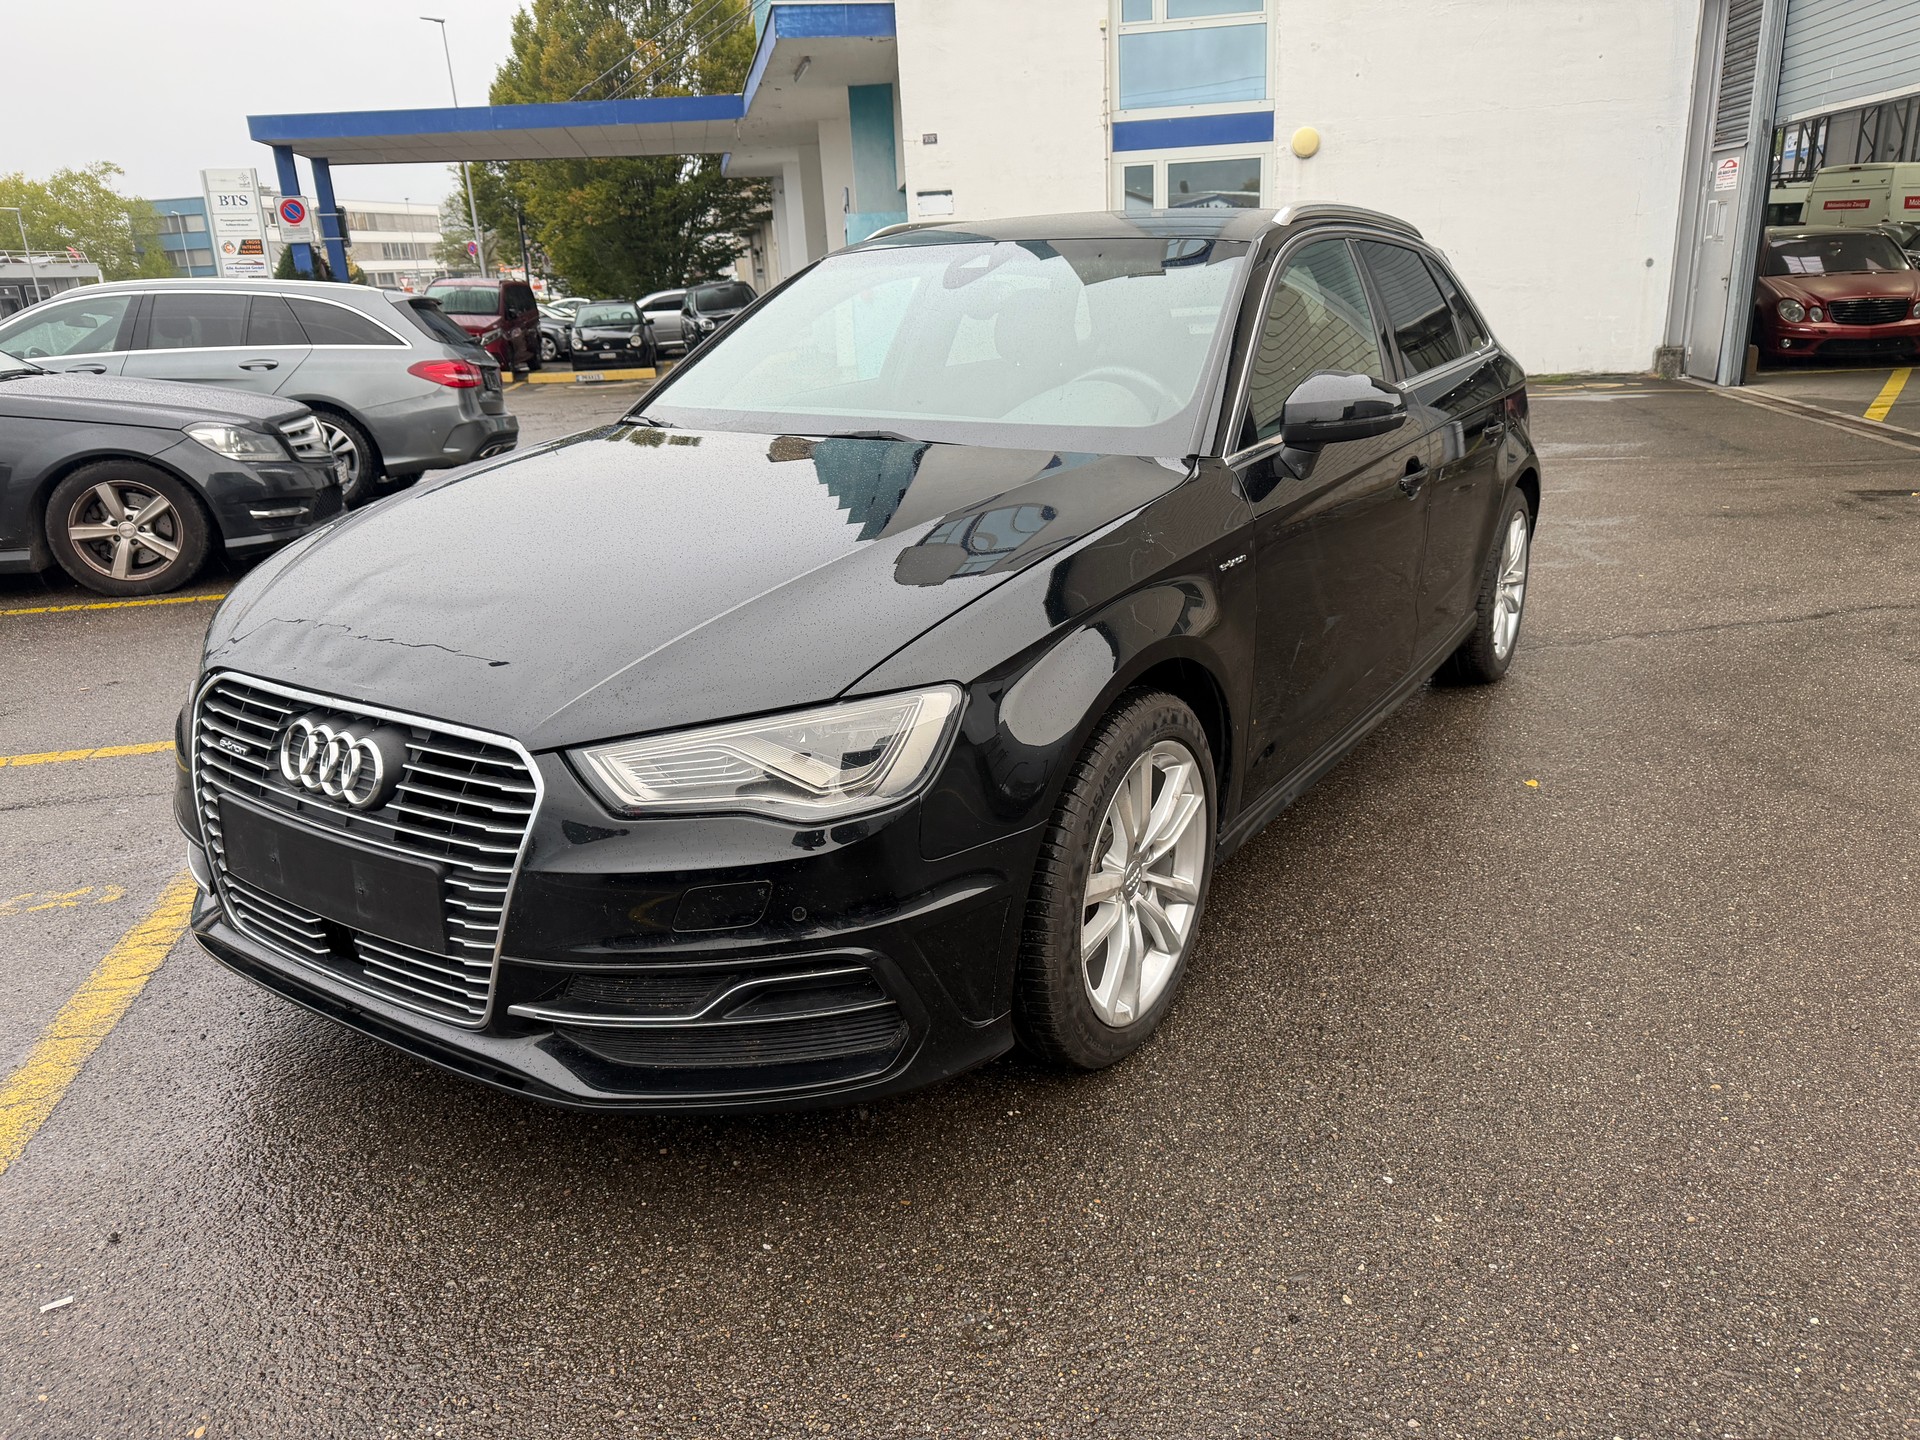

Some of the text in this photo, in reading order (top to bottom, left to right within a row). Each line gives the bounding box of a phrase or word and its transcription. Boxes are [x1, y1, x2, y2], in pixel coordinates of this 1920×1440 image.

[217, 195, 248, 206] BTS
[1219, 554, 1247, 571] e-tron
[219, 738, 247, 755] e-tron
[1083, 763, 1117, 835] 225/45
